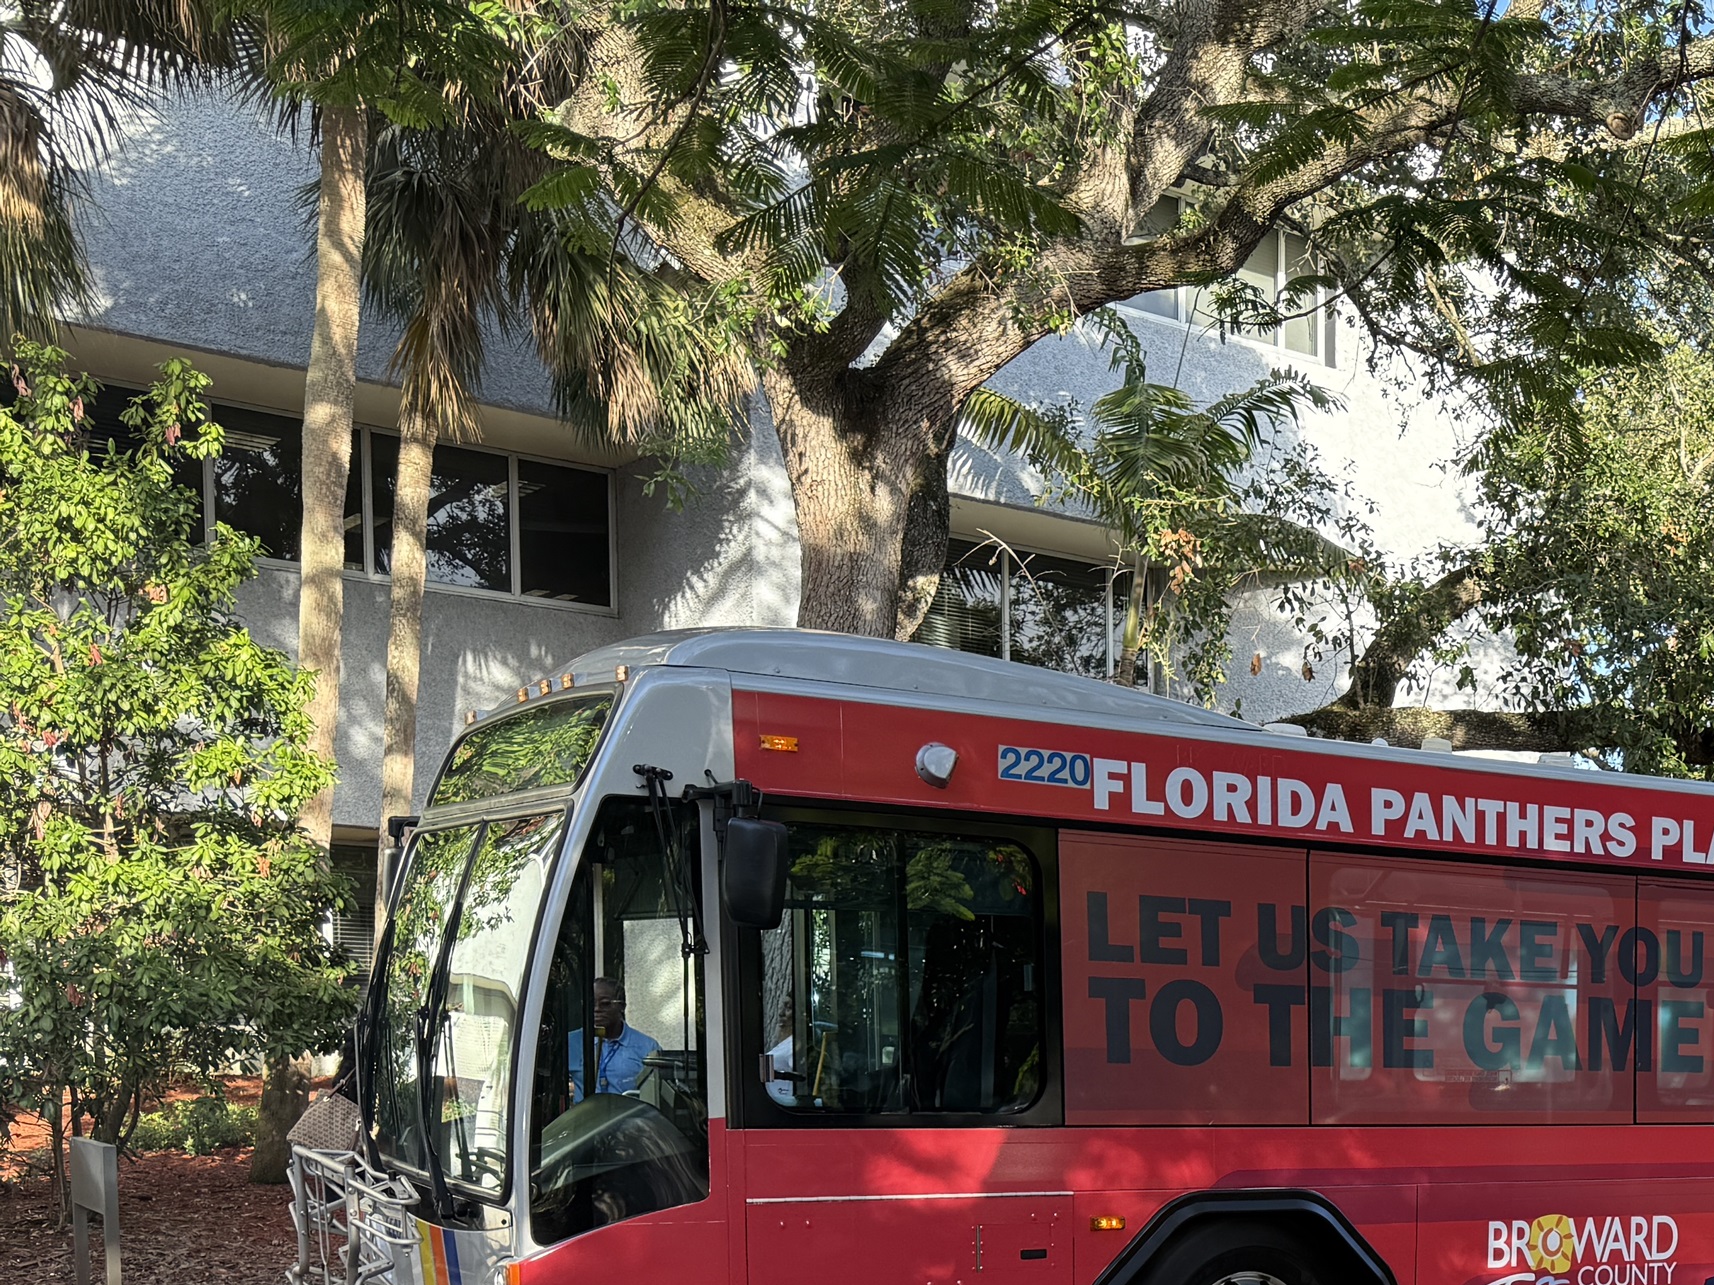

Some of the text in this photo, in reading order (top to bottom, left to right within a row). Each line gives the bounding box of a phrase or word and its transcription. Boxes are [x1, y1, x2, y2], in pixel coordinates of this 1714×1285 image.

[1000, 746, 1090, 787] 2220
[1092, 757, 1354, 834] FLORIDA
[1370, 787, 1637, 858] PANTHERS
[1087, 891, 1704, 988] LET US TAKE YOU
[1088, 976, 1704, 1073] TO THE GAME
[1487, 1215, 1678, 1270] BROWARD
